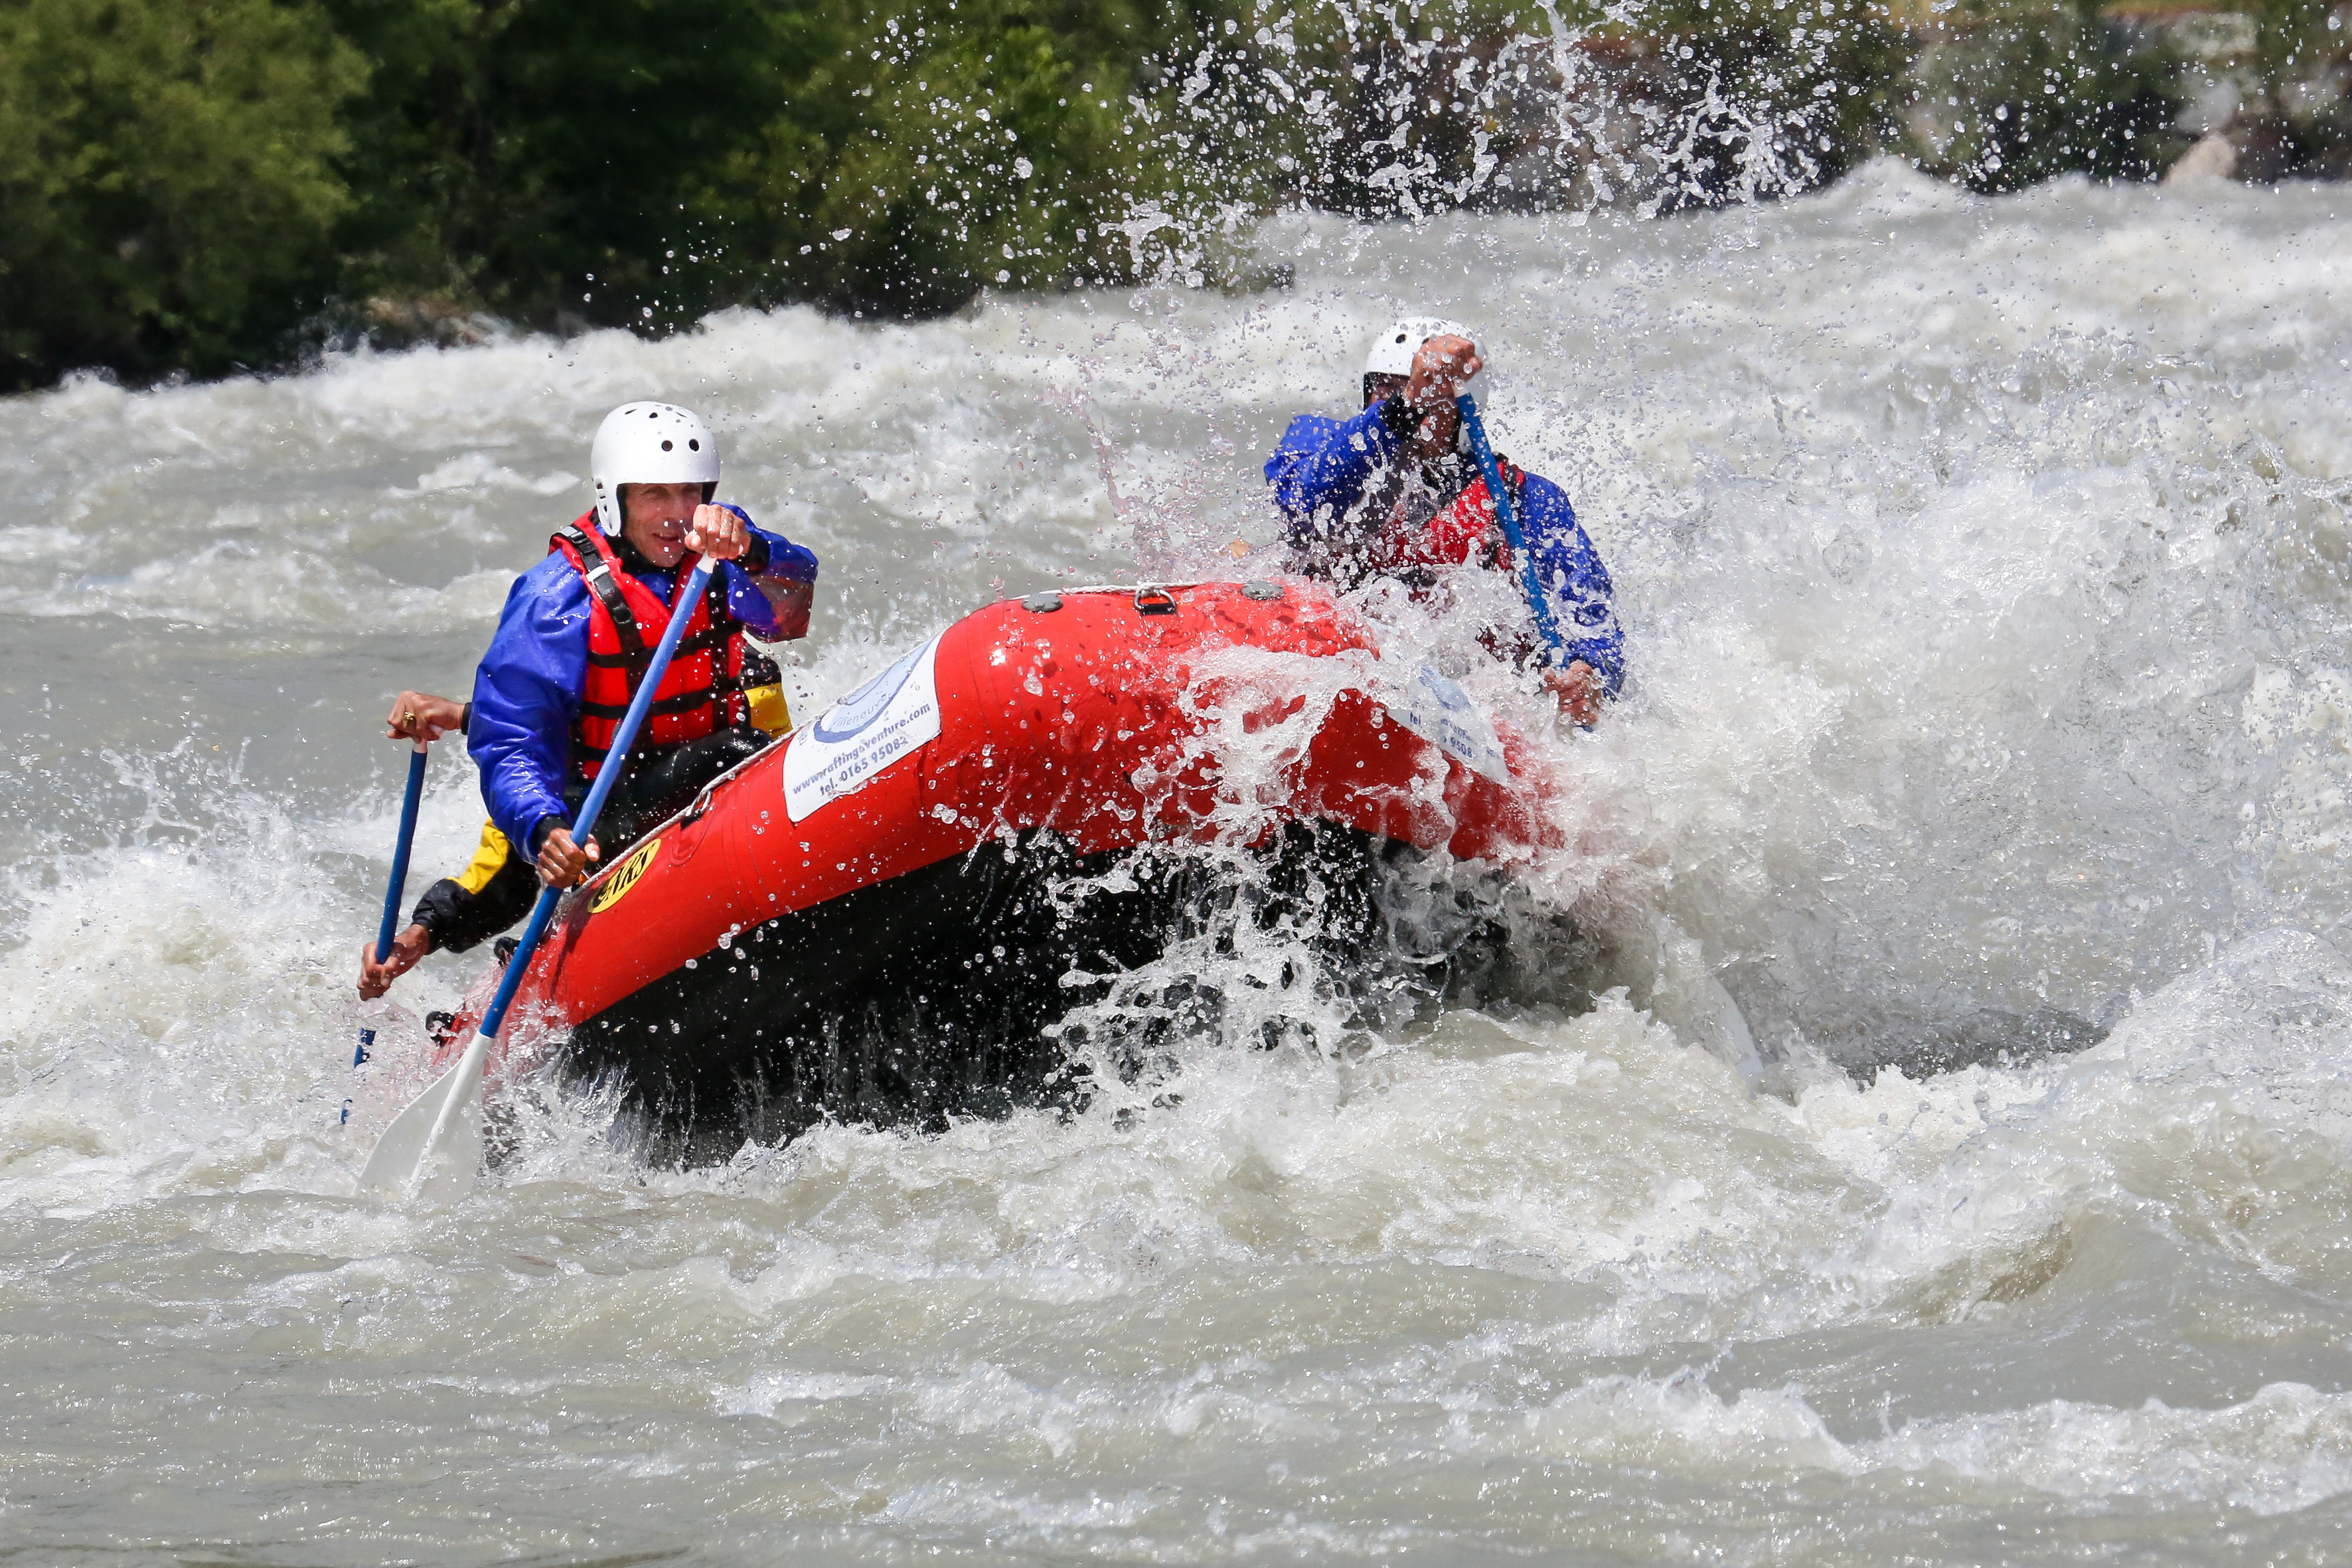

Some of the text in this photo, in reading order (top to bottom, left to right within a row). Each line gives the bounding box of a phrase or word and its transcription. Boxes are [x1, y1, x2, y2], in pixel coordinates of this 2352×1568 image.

[820, 736, 908, 797] tel. 0165 95082
[1450, 736, 1474, 758] 9508
